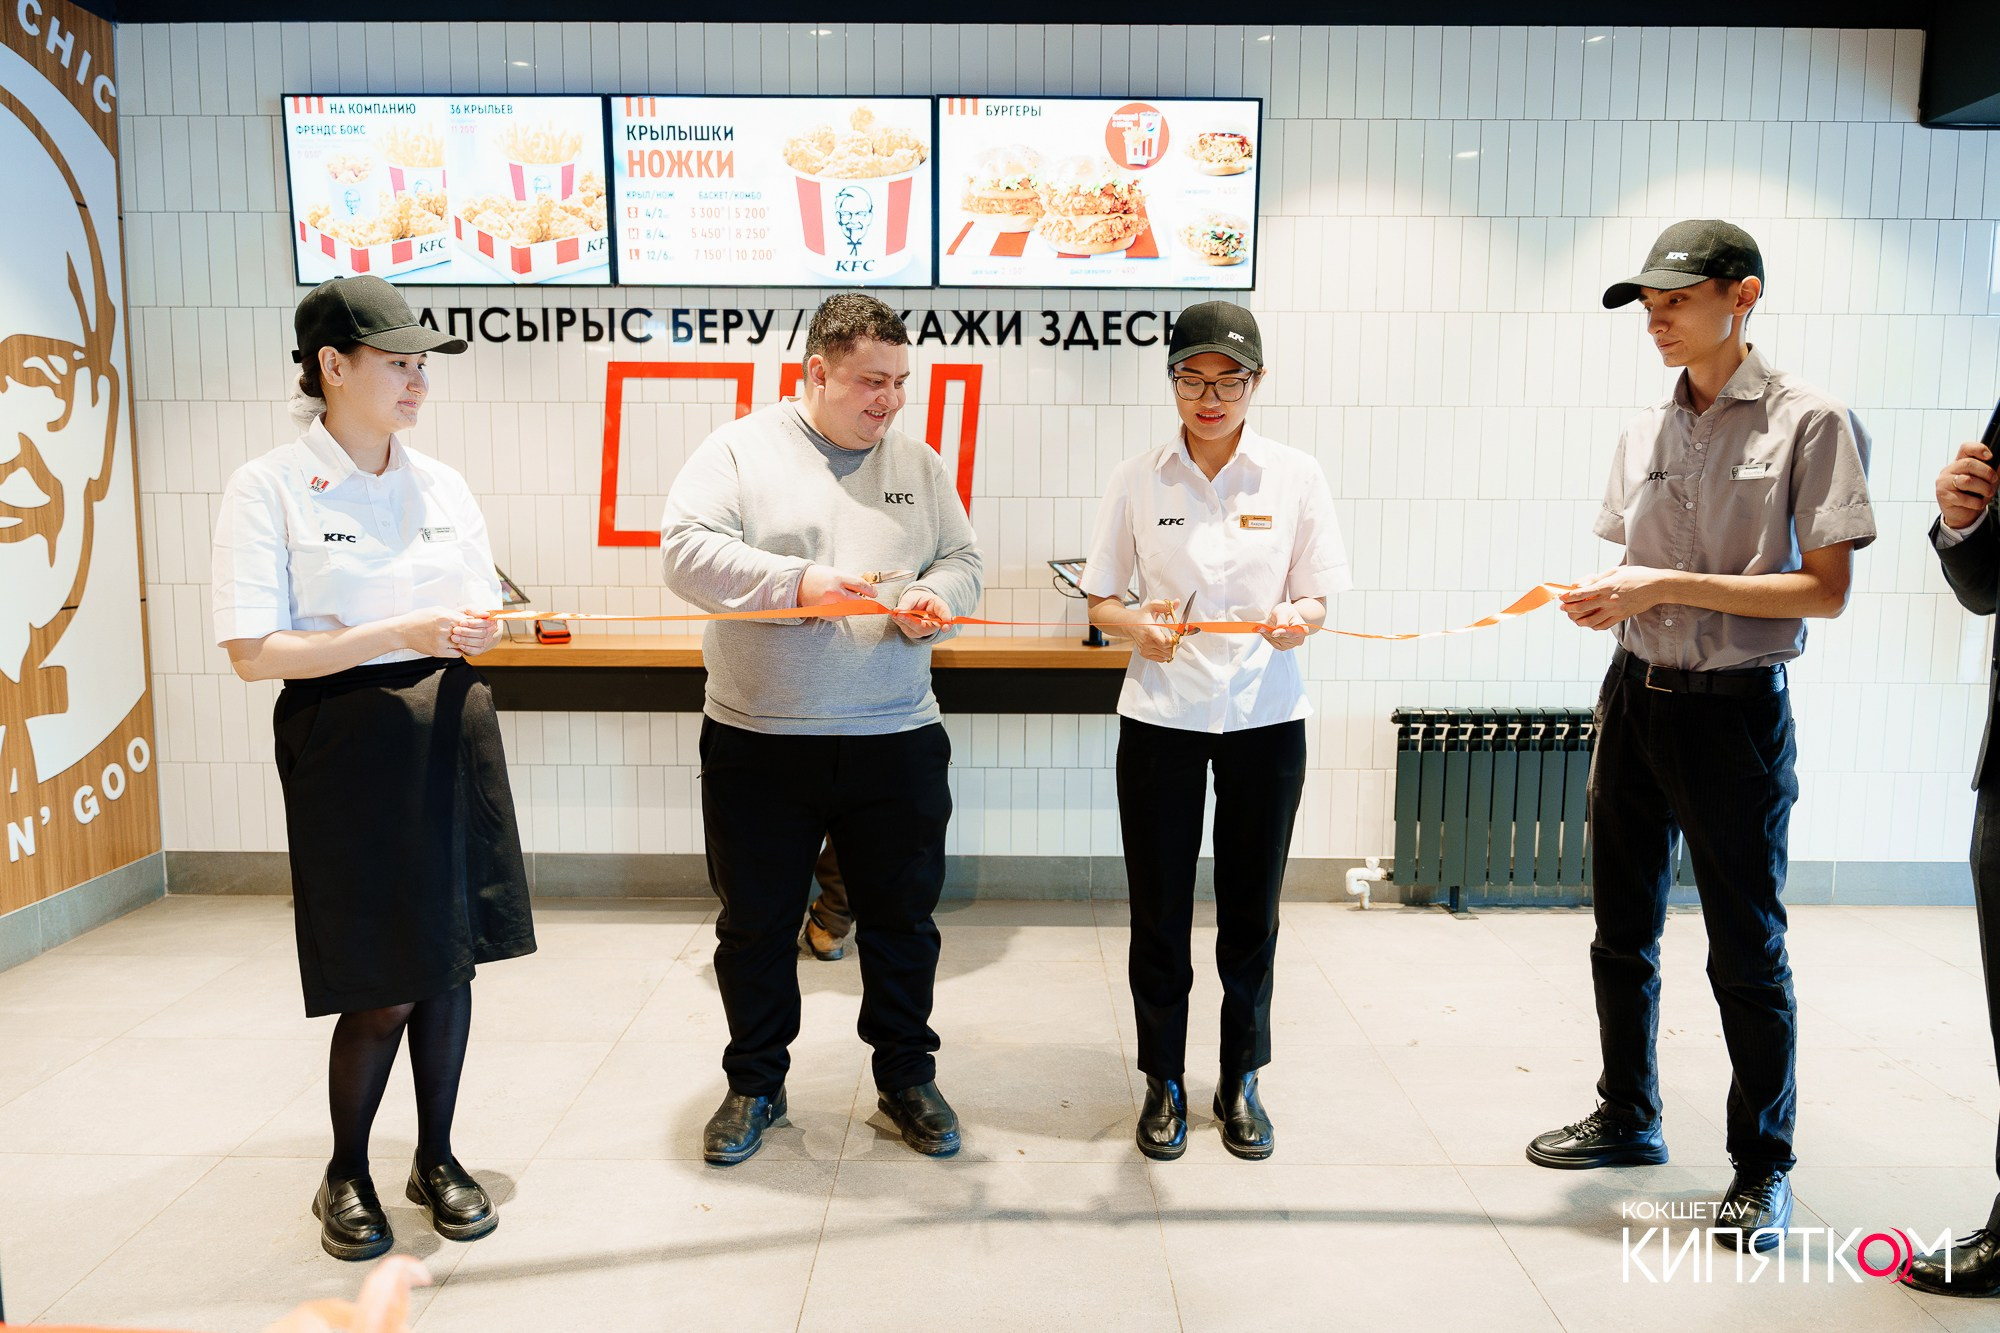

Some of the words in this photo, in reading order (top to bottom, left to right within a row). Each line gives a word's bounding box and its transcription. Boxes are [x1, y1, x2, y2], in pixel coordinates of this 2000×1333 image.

[330, 103, 345, 114] НА
[348, 103, 416, 114] КОМПАНИЮ
[450, 104, 461, 114] 36
[464, 104, 513, 114] КРЫЛЬЕВ
[985, 105, 1042, 117] БУРГЕРЫ
[295, 125, 337, 136] ФРЕНДС
[340, 125, 366, 135] БОКС
[626, 125, 734, 141] КРЫЛЫШКИ
[627, 149, 735, 178] НОЖКИ
[419, 237, 446, 254] KFC
[587, 236, 609, 253] KF
[1666, 251, 1689, 261] KFC
[835, 259, 876, 273] KFC
[418, 307, 654, 343] АПСЫРЫС
[672, 308, 775, 345] БЕРУ
[900, 309, 1022, 346] АЖИ
[1228, 330, 1245, 343] KFC
[1648, 470, 1668, 482] KFC
[883, 491, 915, 505] KFC
[1157, 517, 1185, 527] KFC
[323, 533, 356, 543] KFC
